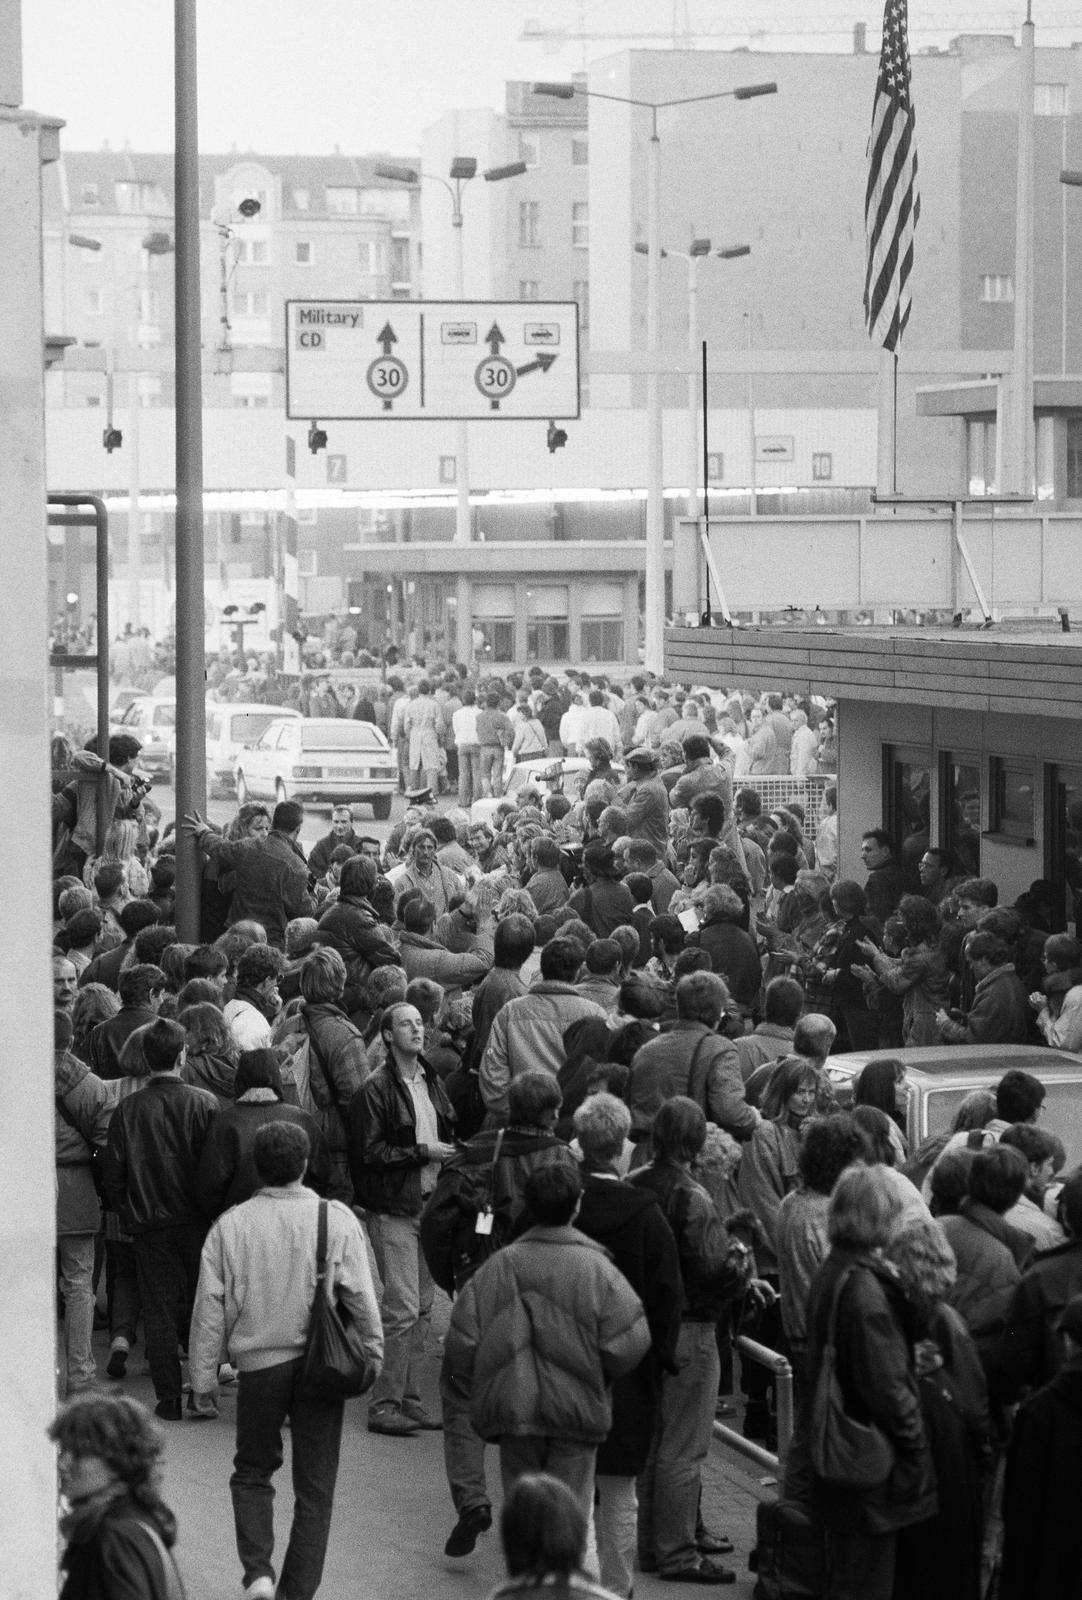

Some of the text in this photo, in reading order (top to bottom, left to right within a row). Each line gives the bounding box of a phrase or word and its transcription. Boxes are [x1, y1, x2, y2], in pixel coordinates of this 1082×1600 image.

[300, 309, 359, 328] Military
[300, 332, 321, 347] CD
[377, 368, 400, 387] 30
[485, 368, 508, 387] 30
[331, 459, 342, 479] 7
